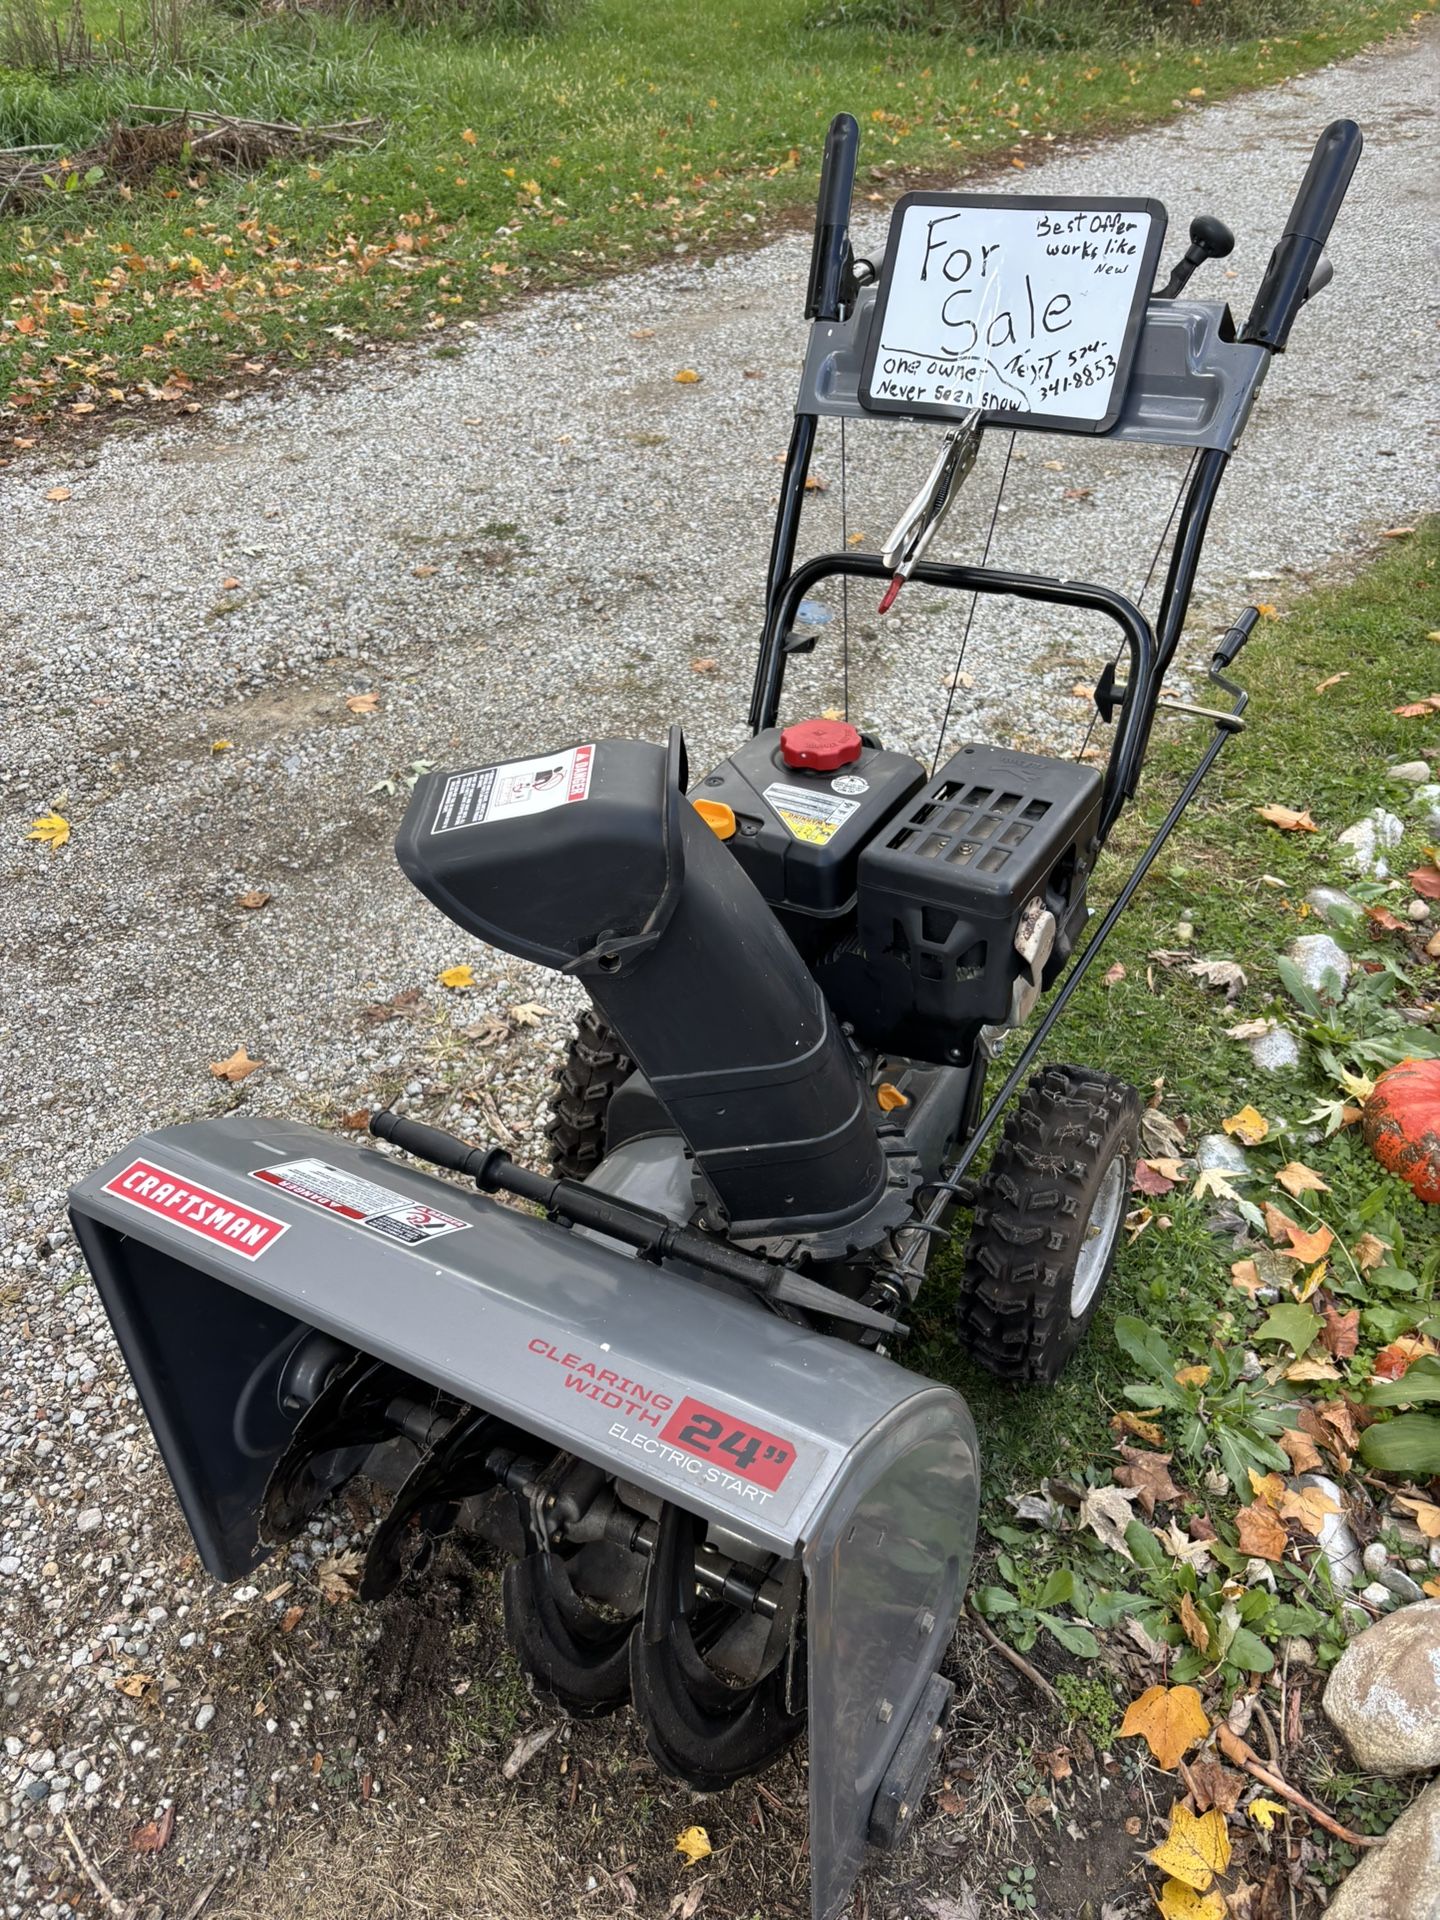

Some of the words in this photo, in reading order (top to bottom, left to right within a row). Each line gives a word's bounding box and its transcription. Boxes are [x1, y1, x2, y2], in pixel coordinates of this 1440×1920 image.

[1036, 213, 1087, 237] Best
[1089, 213, 1138, 235] Offer
[920, 213, 1000, 282] For
[1104, 238, 1136, 255] like
[1094, 263, 1129, 274] New
[941, 274, 1073, 356] Sale
[876, 379, 927, 400] Never
[568, 758, 590, 795] DANGER
[787, 812, 823, 825] WARNING
[121, 1169, 270, 1248] CRAFTSMAN
[277, 1179, 332, 1205] DANGER
[527, 1338, 673, 1411] CLEARING
[564, 1373, 662, 1427] WIDTH
[608, 1422, 703, 1474] ELECTRIC
[704, 1468, 774, 1506] START
